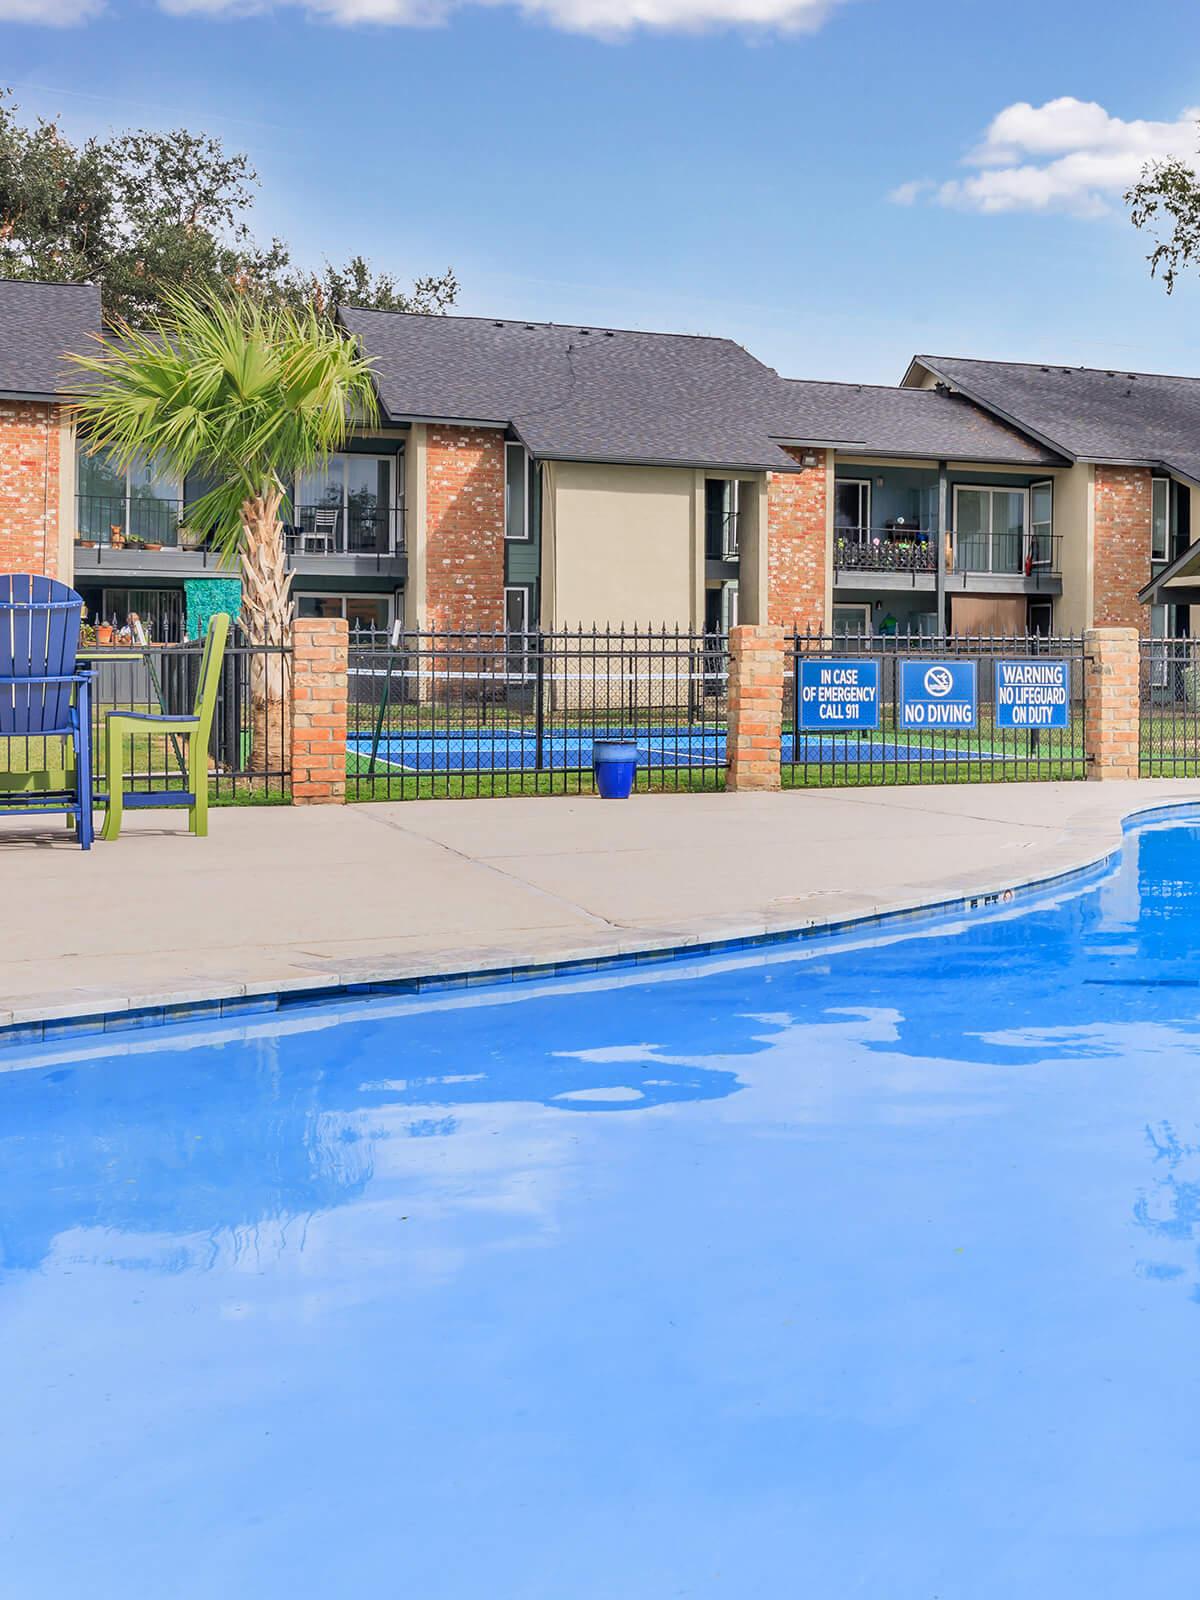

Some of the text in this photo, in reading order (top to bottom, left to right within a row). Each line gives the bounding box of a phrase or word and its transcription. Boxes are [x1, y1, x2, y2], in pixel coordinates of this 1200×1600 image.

[821, 669, 858, 685] IN CASE
[1003, 666, 1063, 684] WARNING
[803, 686, 875, 702] OF EMERGENCY
[1000, 687, 1066, 705] NO LIFEGUARD
[819, 704, 859, 719] CALL 911
[905, 705, 972, 723] NO DIVING
[1012, 706, 1053, 723] ON DUTY
